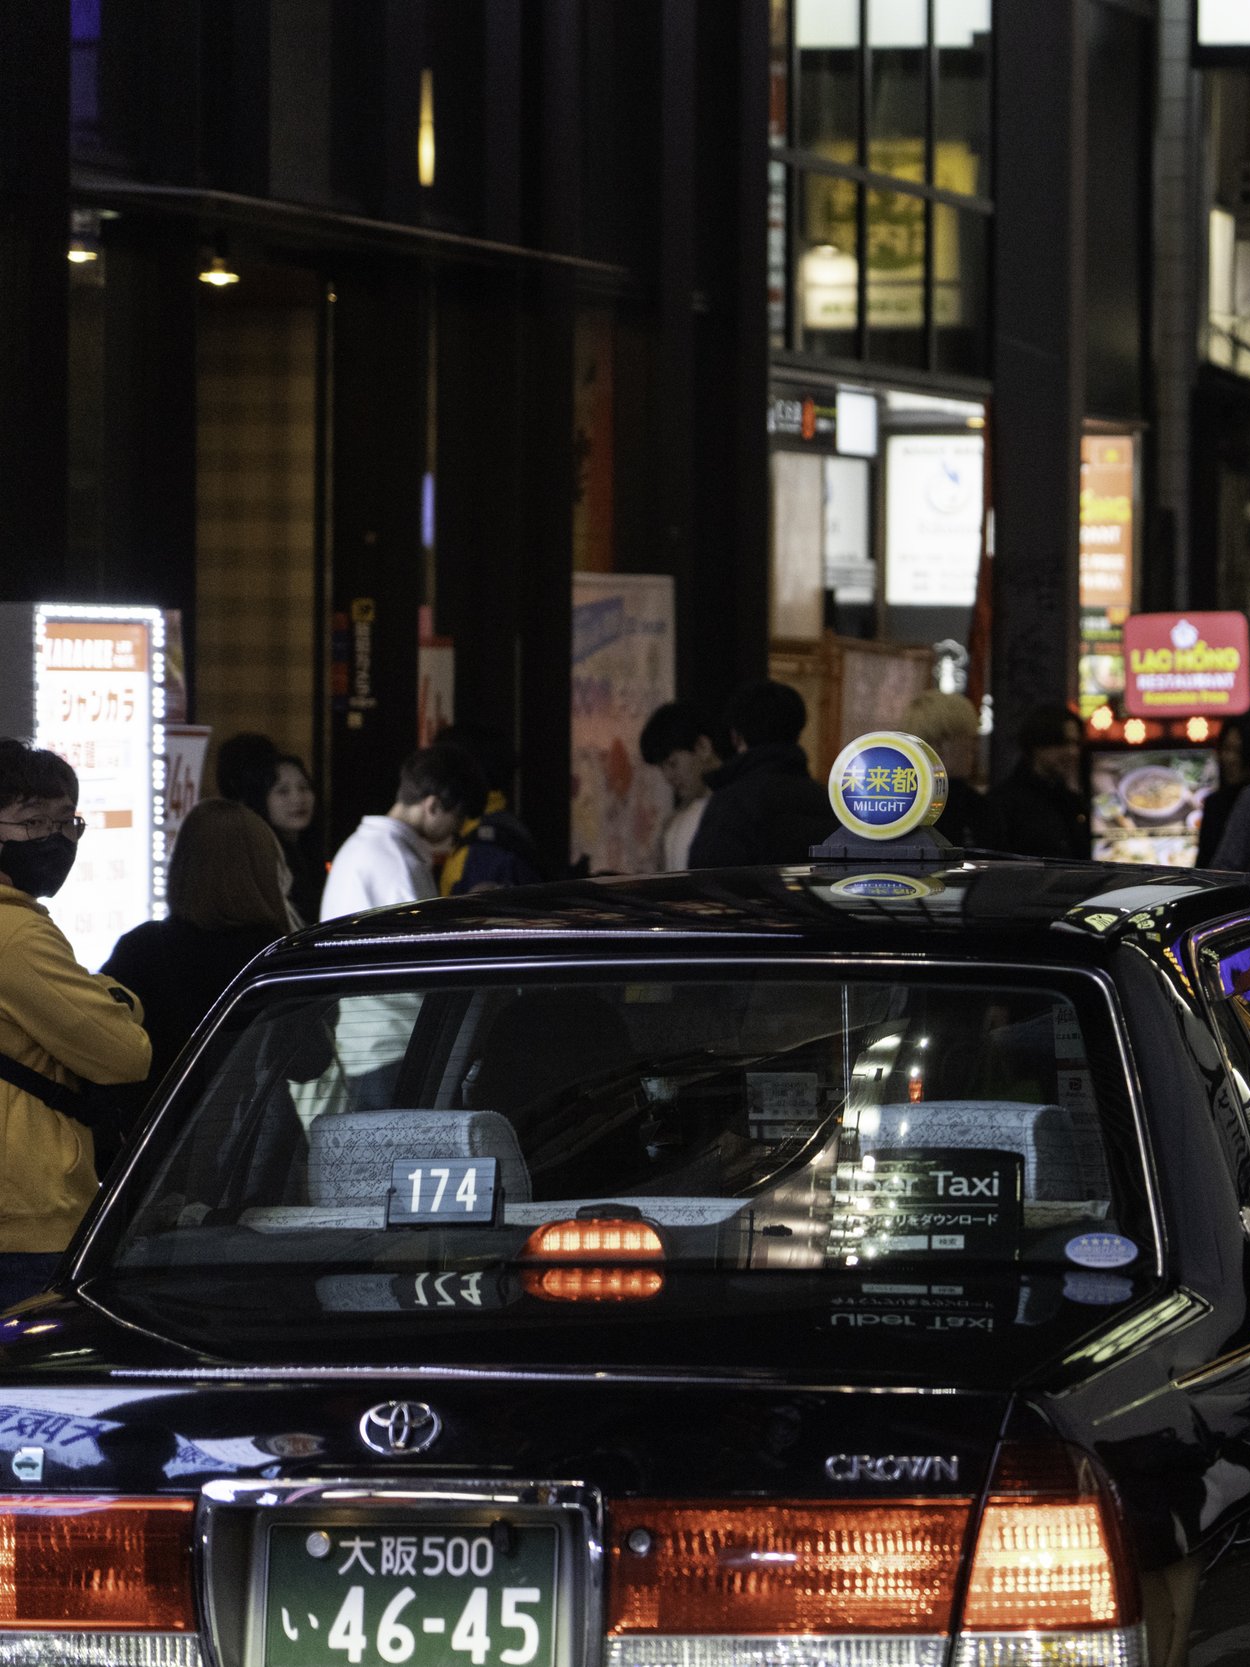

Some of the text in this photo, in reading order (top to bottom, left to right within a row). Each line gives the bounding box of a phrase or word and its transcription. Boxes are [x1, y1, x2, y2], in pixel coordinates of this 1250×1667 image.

[841, 766, 918, 793] 未来都
[853, 801, 907, 812] MILIGHT
[408, 1168, 478, 1213] 174
[830, 1171, 999, 1197] Uber Taxi
[825, 1454, 960, 1481] CROWN
[338, 1536, 494, 1577] 大阪500
[281, 1586, 541, 1664] い 46-45
